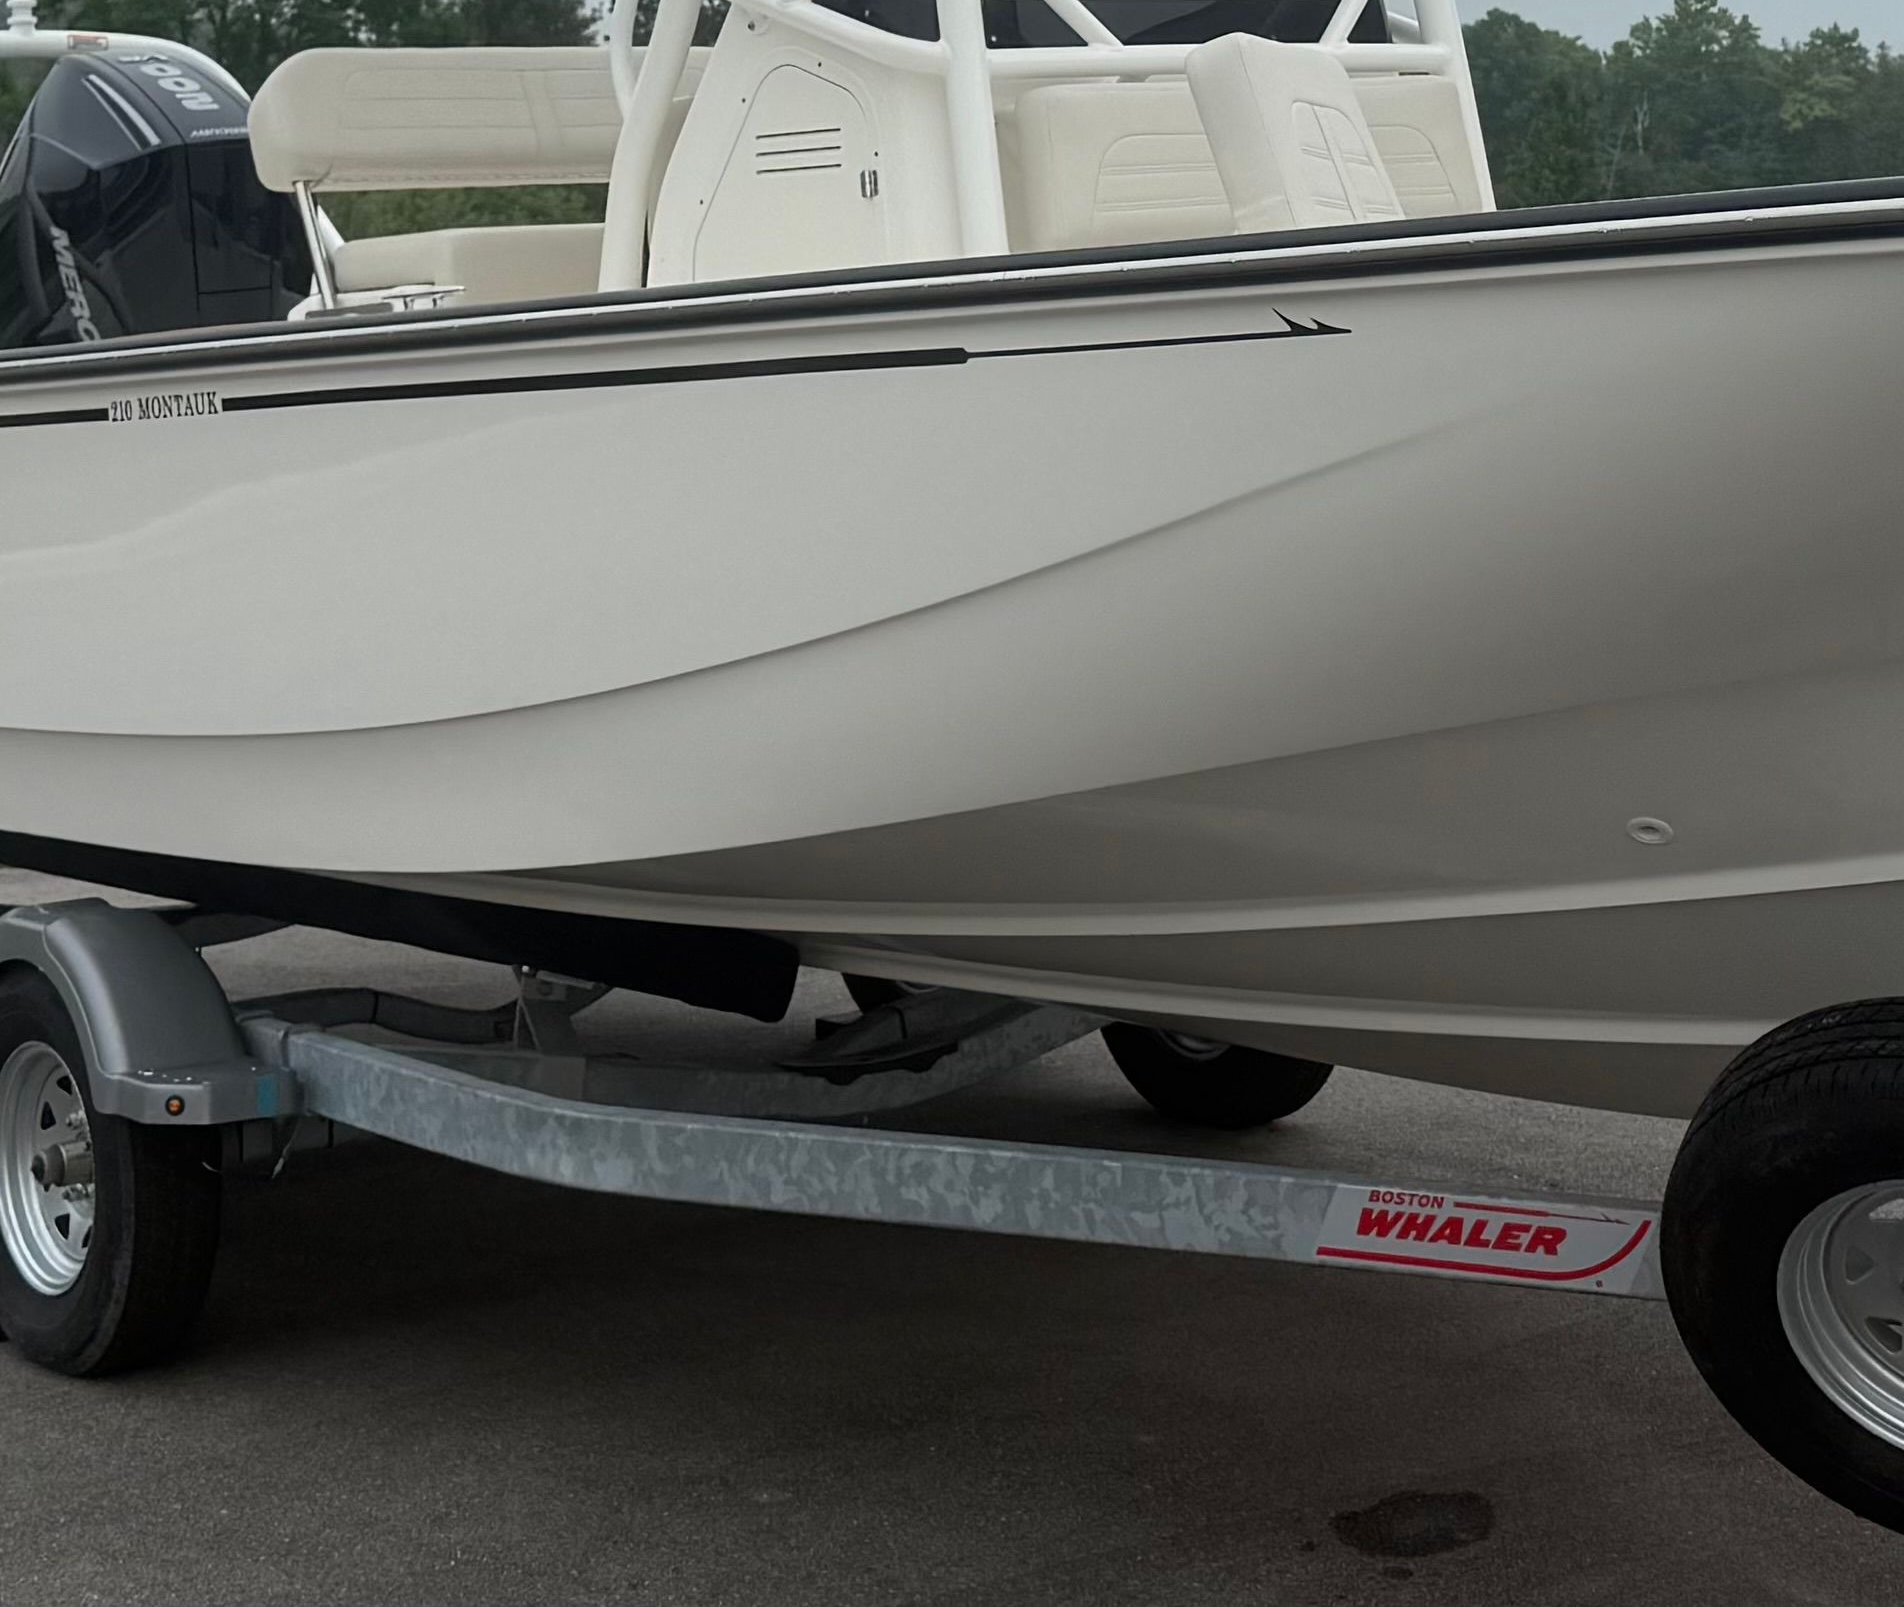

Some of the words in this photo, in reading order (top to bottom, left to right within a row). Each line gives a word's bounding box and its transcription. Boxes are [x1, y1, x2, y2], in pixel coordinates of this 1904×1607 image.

[110, 400, 133, 422] 210
[137, 391, 219, 420] MONTAUK
[1368, 1189, 1445, 1209] BOSTON
[1356, 1207, 1568, 1256] WHALER
